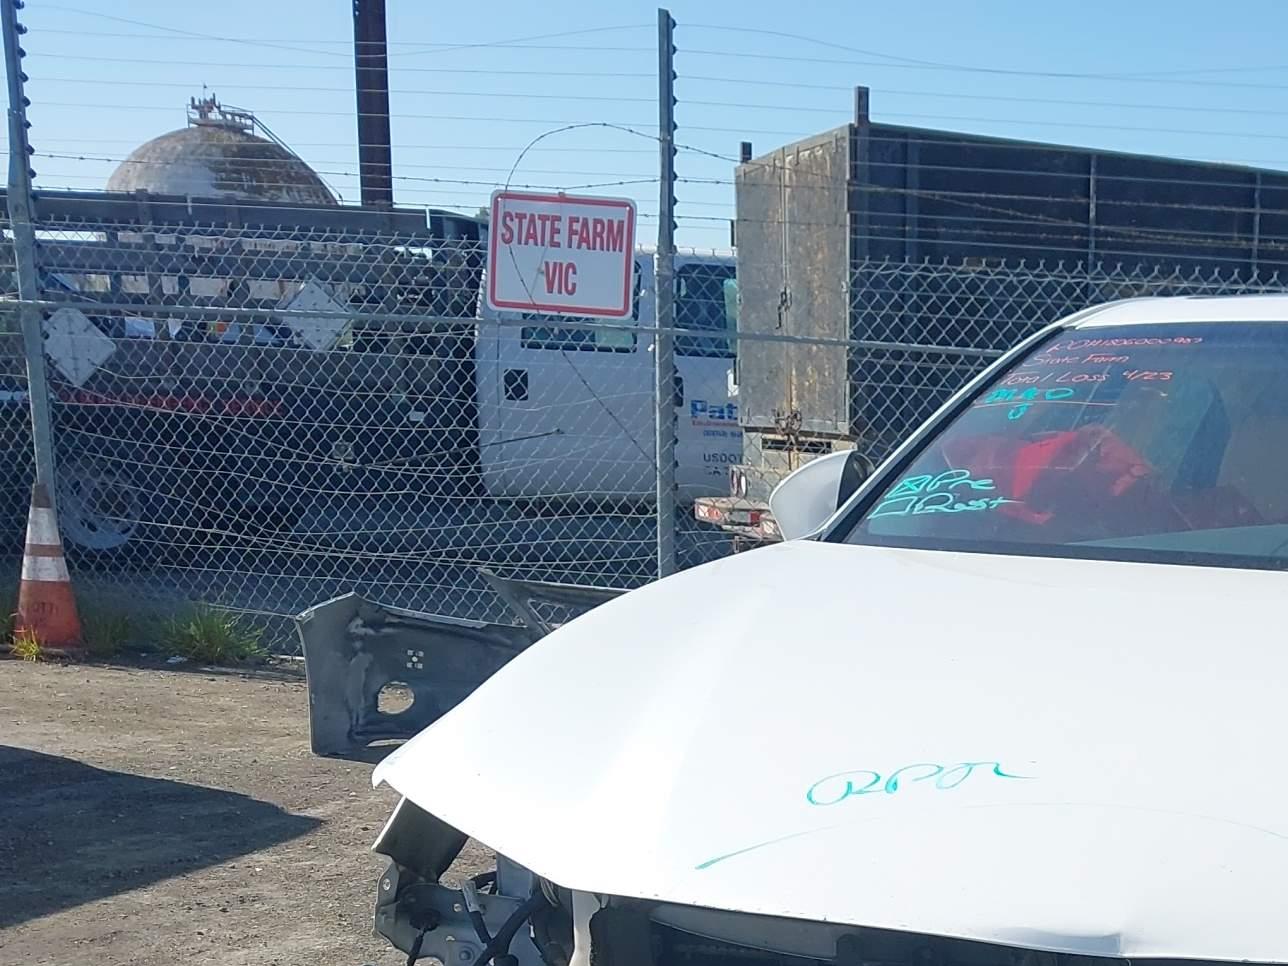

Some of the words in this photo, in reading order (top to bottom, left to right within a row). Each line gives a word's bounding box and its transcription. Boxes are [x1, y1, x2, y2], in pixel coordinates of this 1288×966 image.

[501, 211, 562, 248] STATE
[567, 216, 625, 252] FARM
[543, 260, 577, 295] VIC
